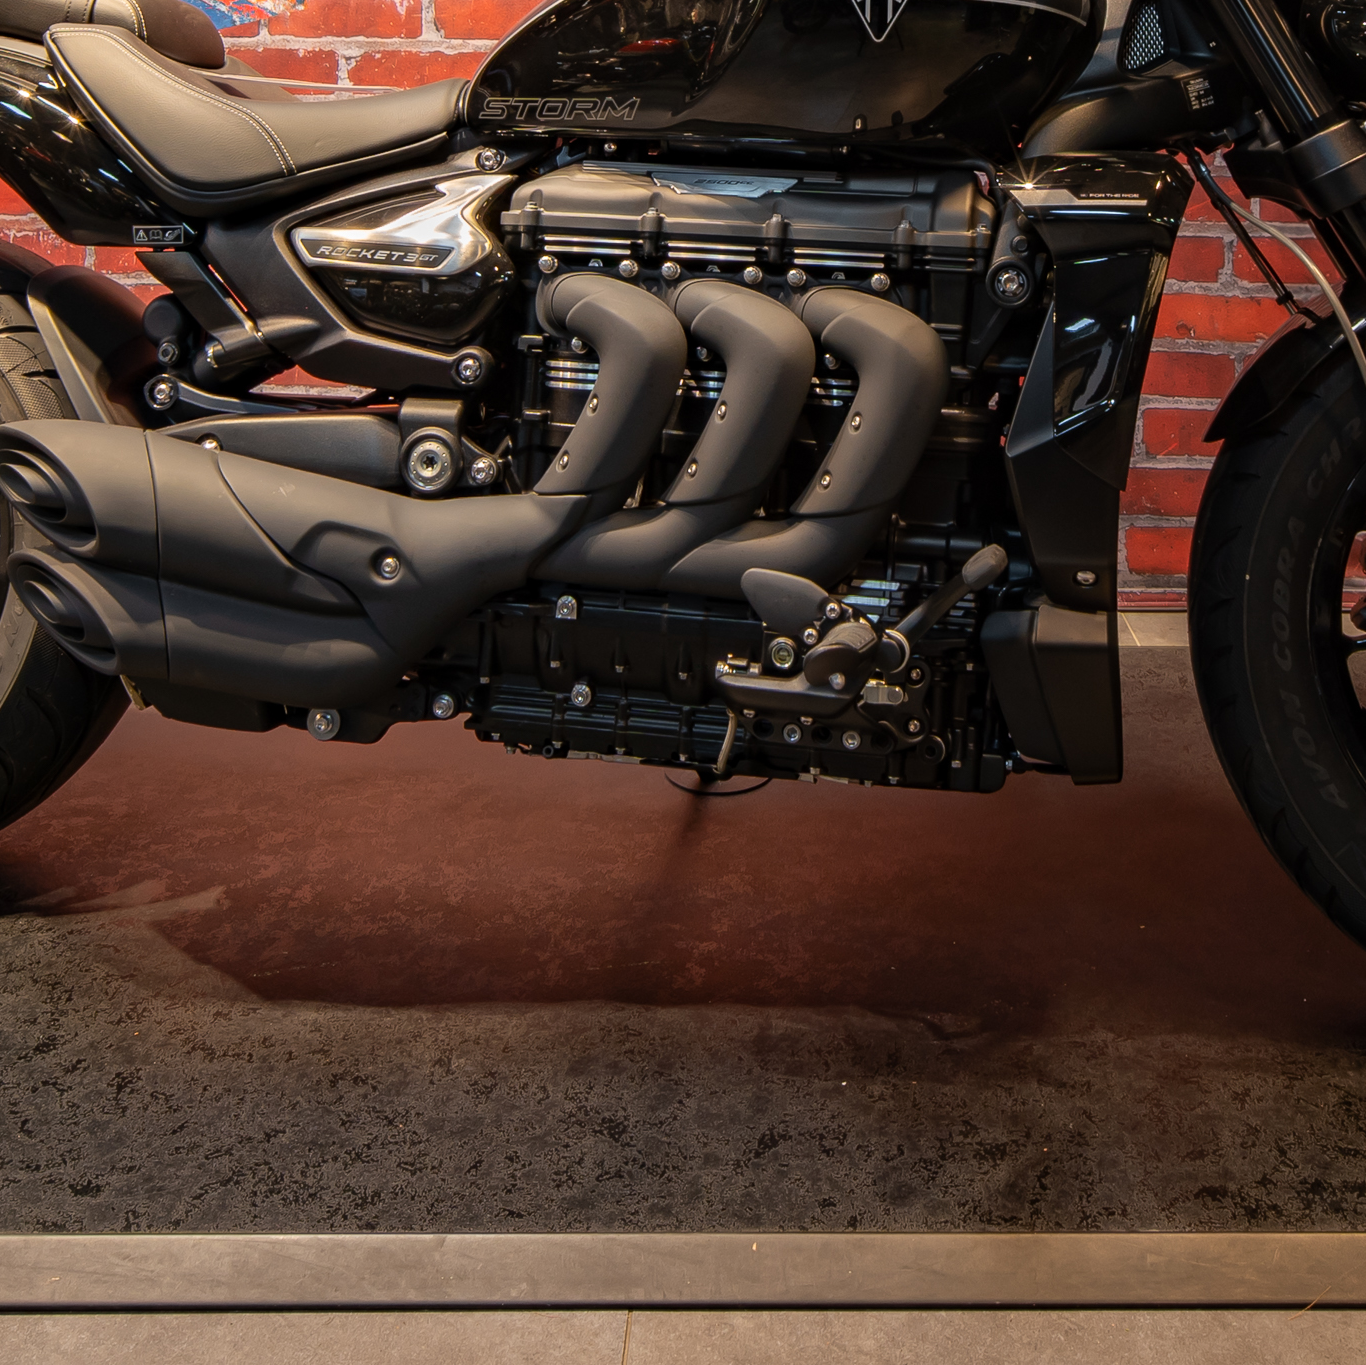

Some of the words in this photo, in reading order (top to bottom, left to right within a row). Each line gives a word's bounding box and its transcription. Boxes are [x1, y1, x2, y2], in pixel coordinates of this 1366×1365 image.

[478, 97, 640, 120] STORM
[1271, 515, 1306, 672] COBRA
[1280, 688, 1350, 810] AVON
